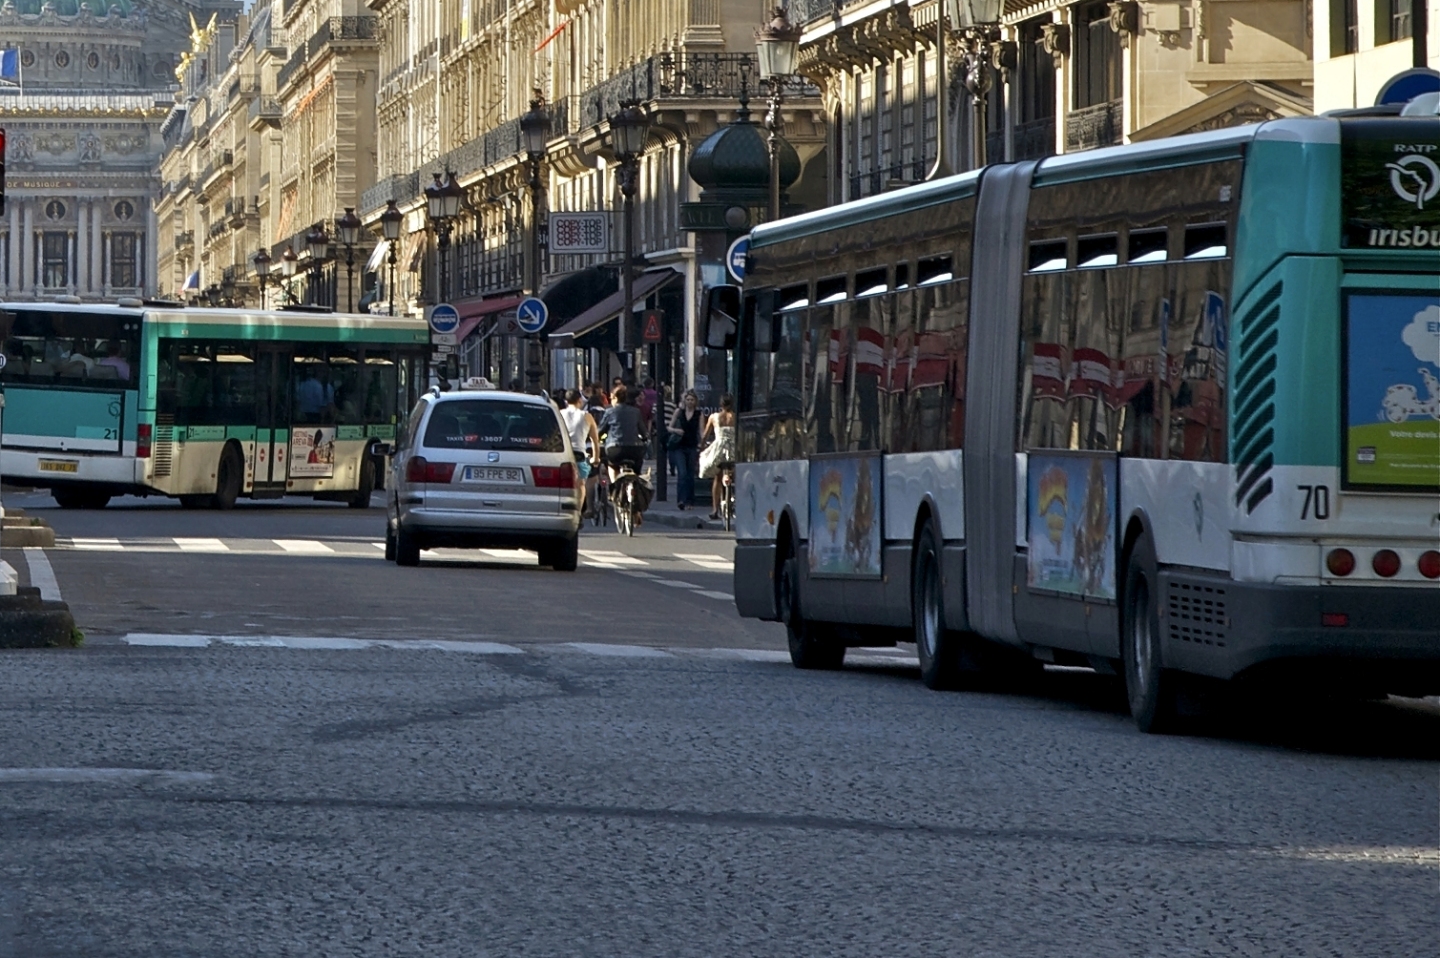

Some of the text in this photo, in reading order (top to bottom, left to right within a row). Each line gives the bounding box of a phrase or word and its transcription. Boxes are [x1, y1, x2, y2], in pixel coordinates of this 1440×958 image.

[1394, 144, 1438, 153] RATP
[104, 428, 118, 440] 21
[189, 427, 195, 437] 21
[1390, 430, 1437, 439] Votre devis
[473, 470, 518, 480] 95 FPE 92
[1297, 485, 1330, 521] 70
